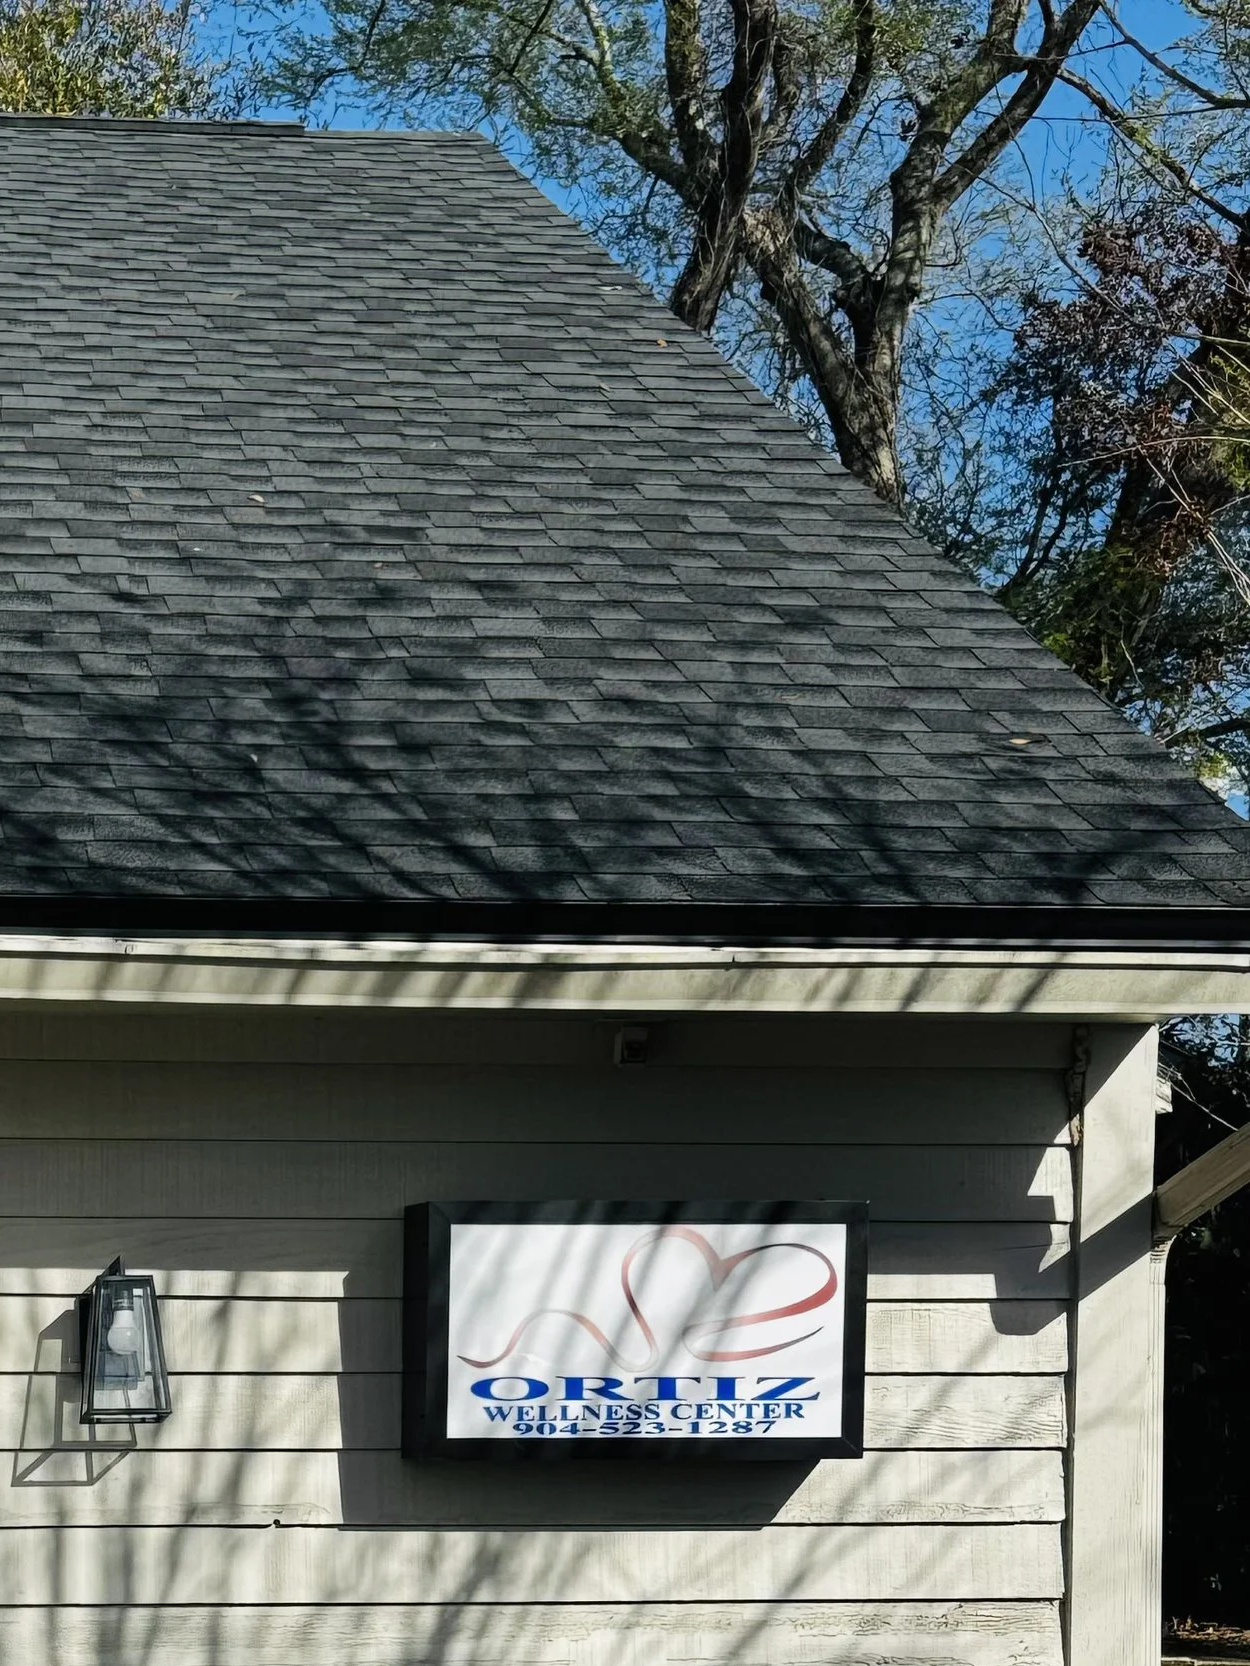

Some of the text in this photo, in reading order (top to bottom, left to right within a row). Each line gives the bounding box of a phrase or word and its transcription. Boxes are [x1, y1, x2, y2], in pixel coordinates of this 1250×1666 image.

[469, 1375, 822, 1402] ORTIZ
[483, 1401, 805, 1422] WELLNESS CENTER
[512, 1420, 778, 1436] 904-523-1287
